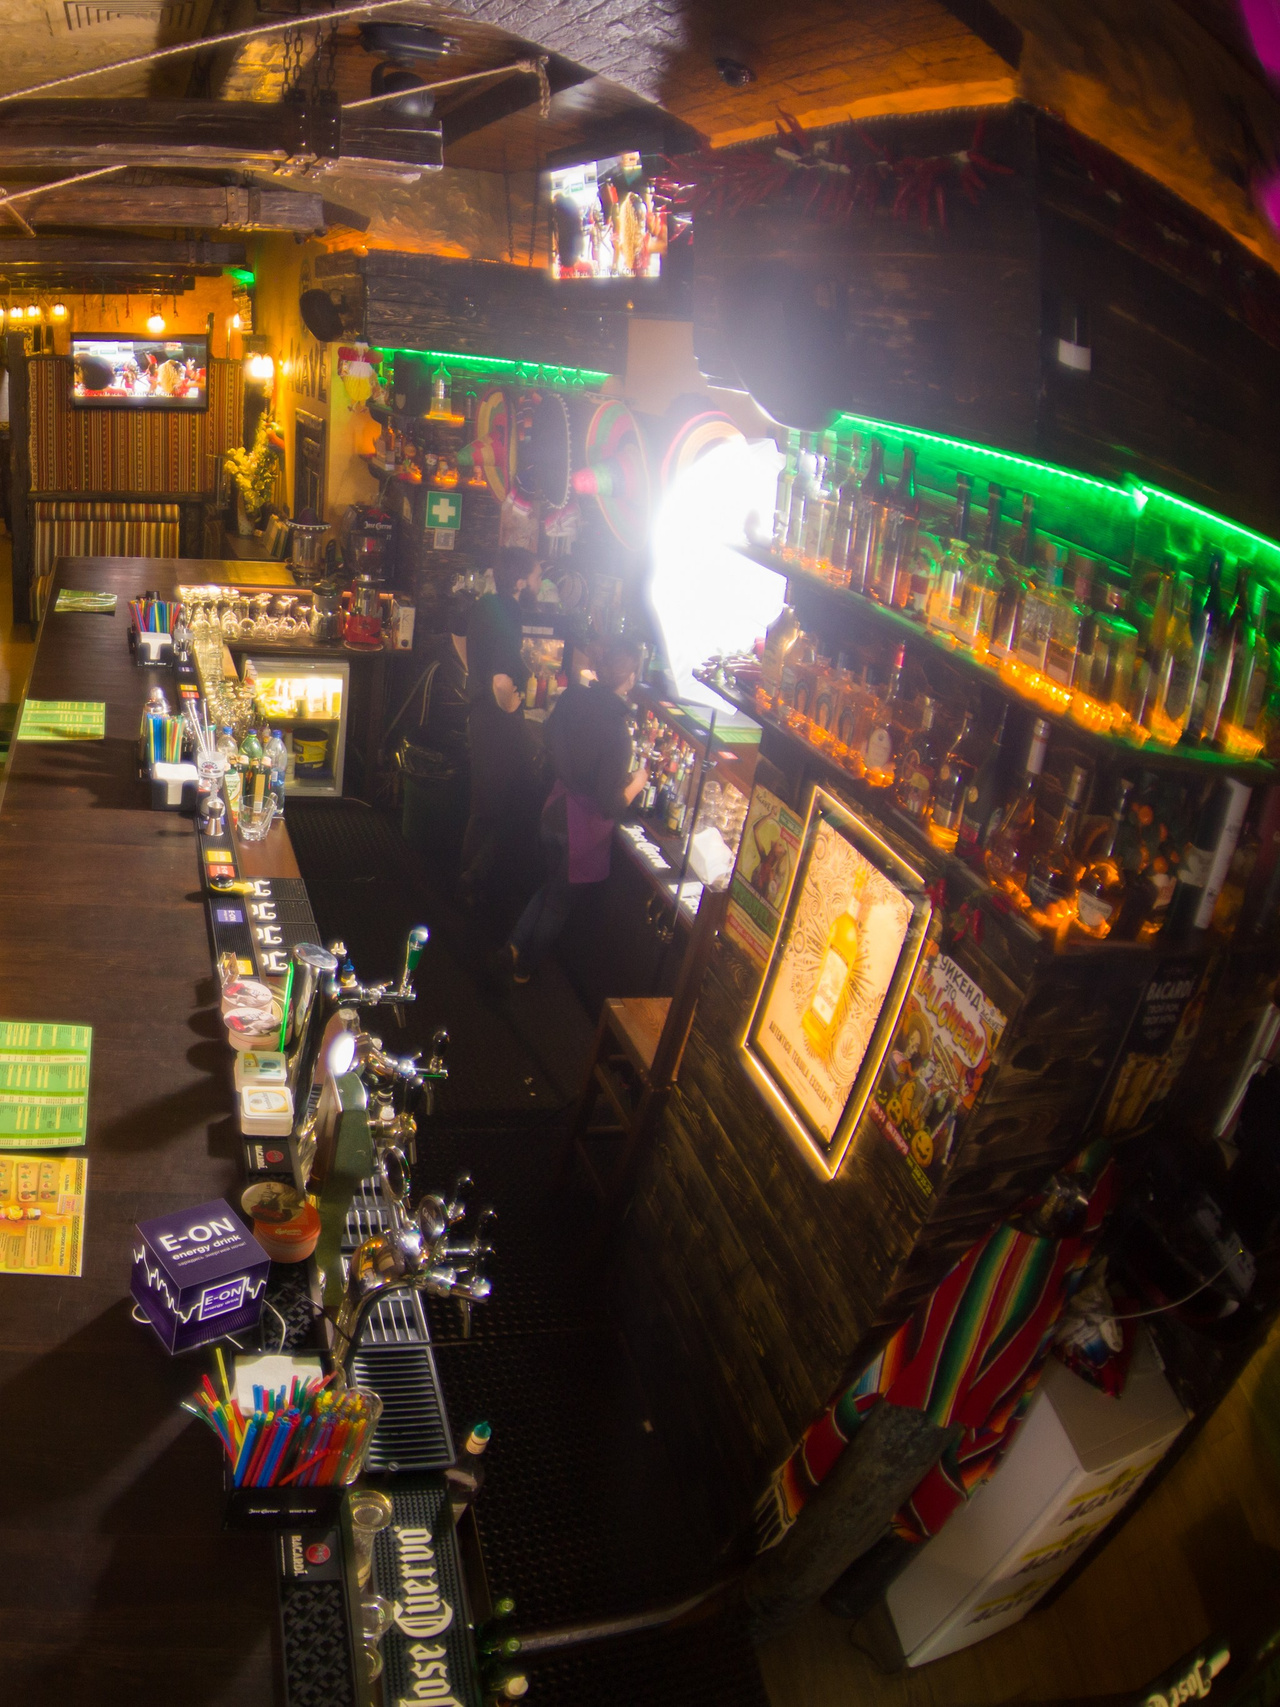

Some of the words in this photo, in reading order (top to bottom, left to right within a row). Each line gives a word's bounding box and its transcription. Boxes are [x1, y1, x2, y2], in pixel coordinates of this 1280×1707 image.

[938, 949, 982, 1012] УИКЕНД
[942, 978, 958, 1002] ЭТО
[790, 1048, 809, 1080] TEQUILA
[808, 1072, 833, 1114] EXCELENTE
[255, 1145, 268, 1170] BACARDÍ
[159, 1217, 236, 1252] E-ON
[172, 1246, 211, 1261] energy
[213, 1234, 242, 1248] drink
[204, 1302, 224, 1312] energy
[225, 1297, 240, 1306] drink
[205, 1285, 242, 1306] E-ON
[291, 1535, 308, 1577] BACARDÍ
[393, 1528, 453, 1638] Cuervo
